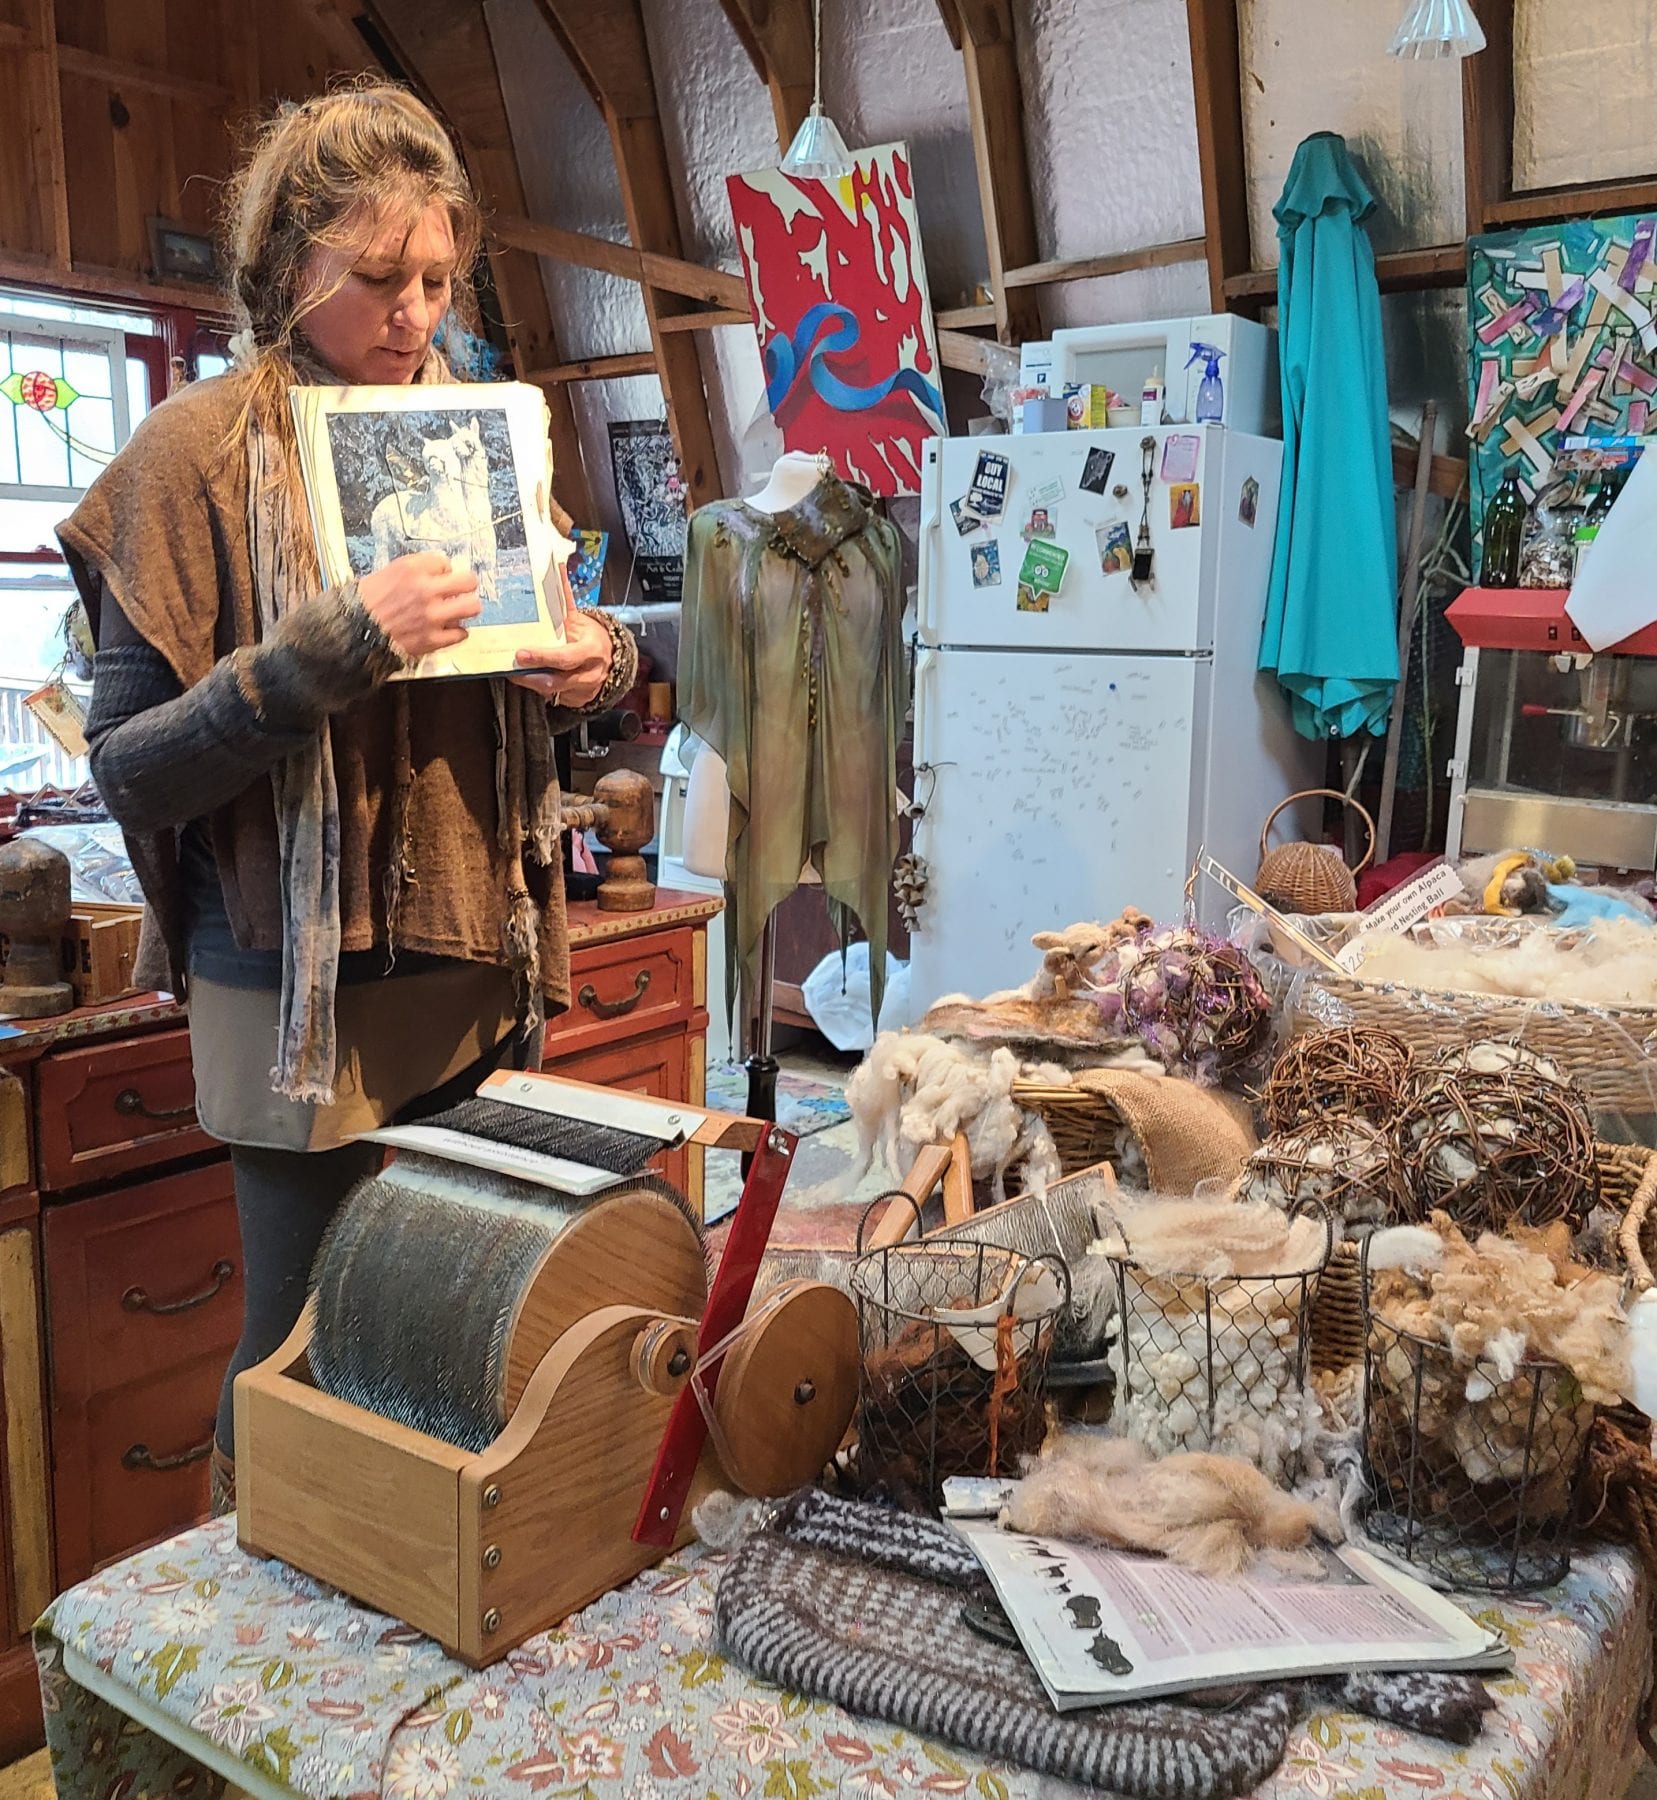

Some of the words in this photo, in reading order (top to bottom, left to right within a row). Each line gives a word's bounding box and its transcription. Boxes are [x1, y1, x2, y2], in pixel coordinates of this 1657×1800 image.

[976, 474, 1004, 493] LOCAL
[1365, 915, 1385, 929] Make
[1386, 901, 1402, 920] your
[1402, 890, 1418, 905] own
[1418, 870, 1446, 893] Alpaca
[1398, 901, 1428, 925] Nesting
[1426, 887, 1444, 904] Ball
